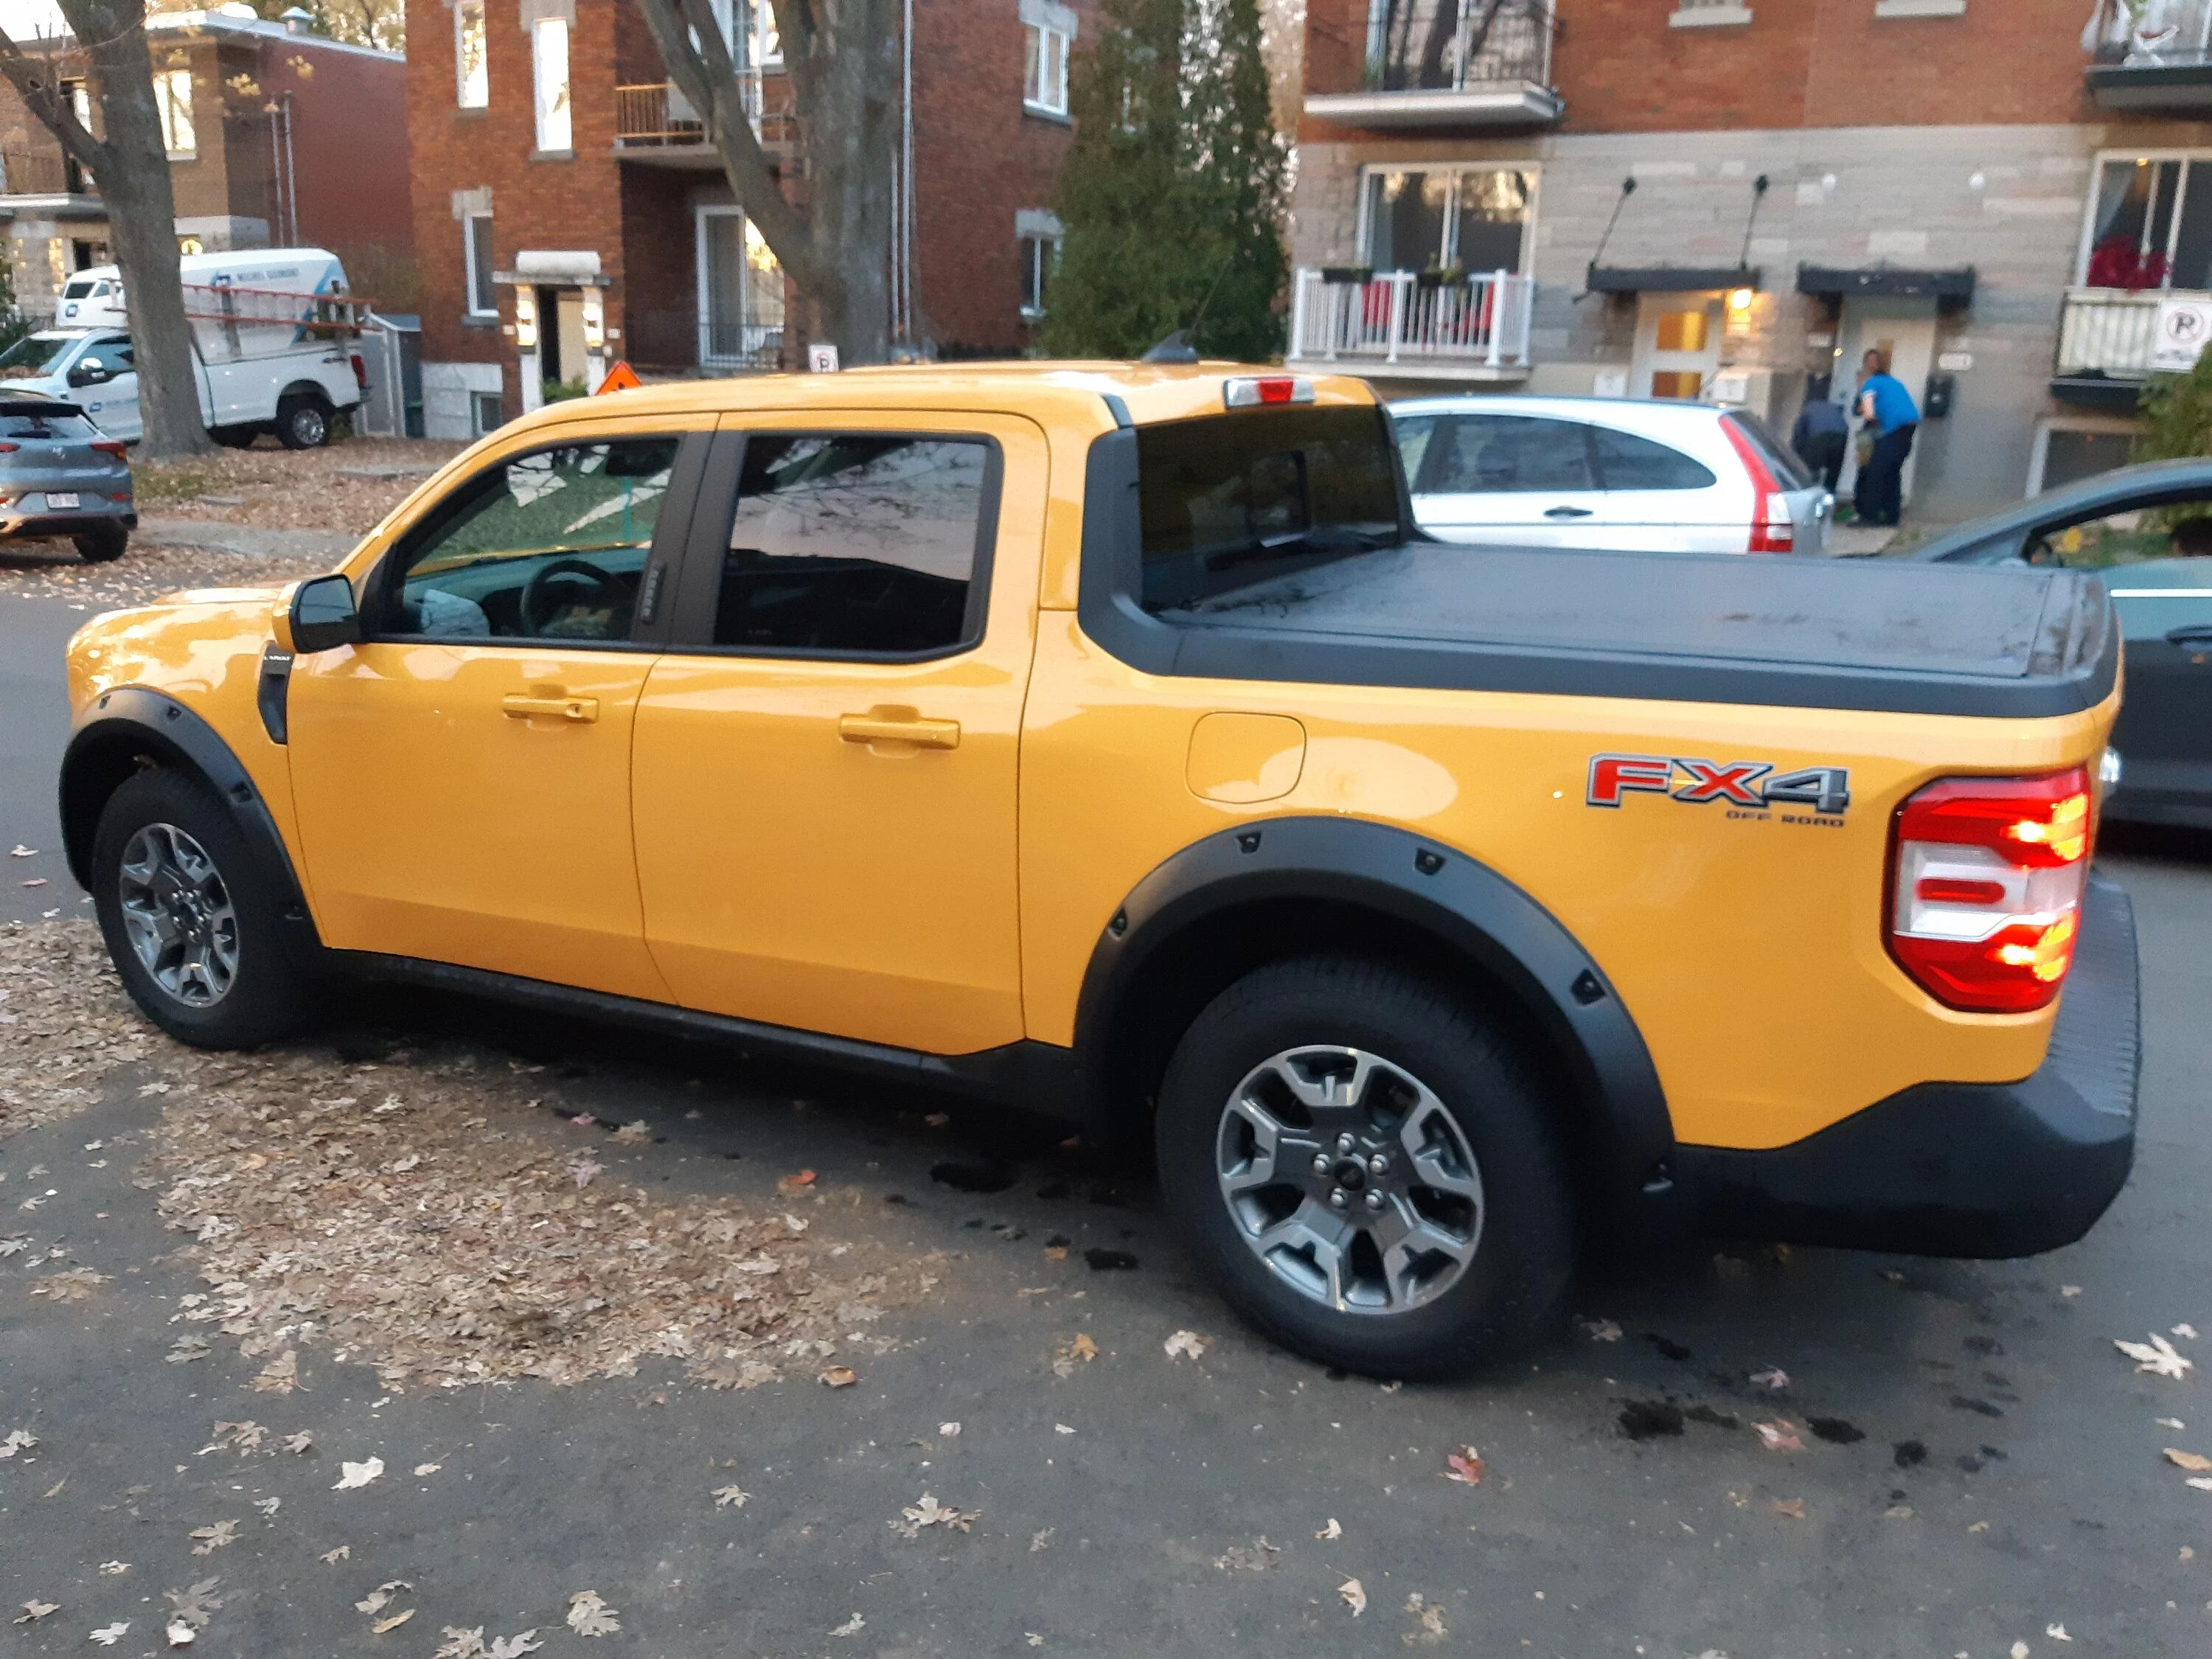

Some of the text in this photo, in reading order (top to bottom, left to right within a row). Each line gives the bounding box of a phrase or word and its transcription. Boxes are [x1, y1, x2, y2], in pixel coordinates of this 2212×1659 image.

[1587, 753, 1849, 814] FX4
[1726, 810, 1845, 827] OFF ROAD
